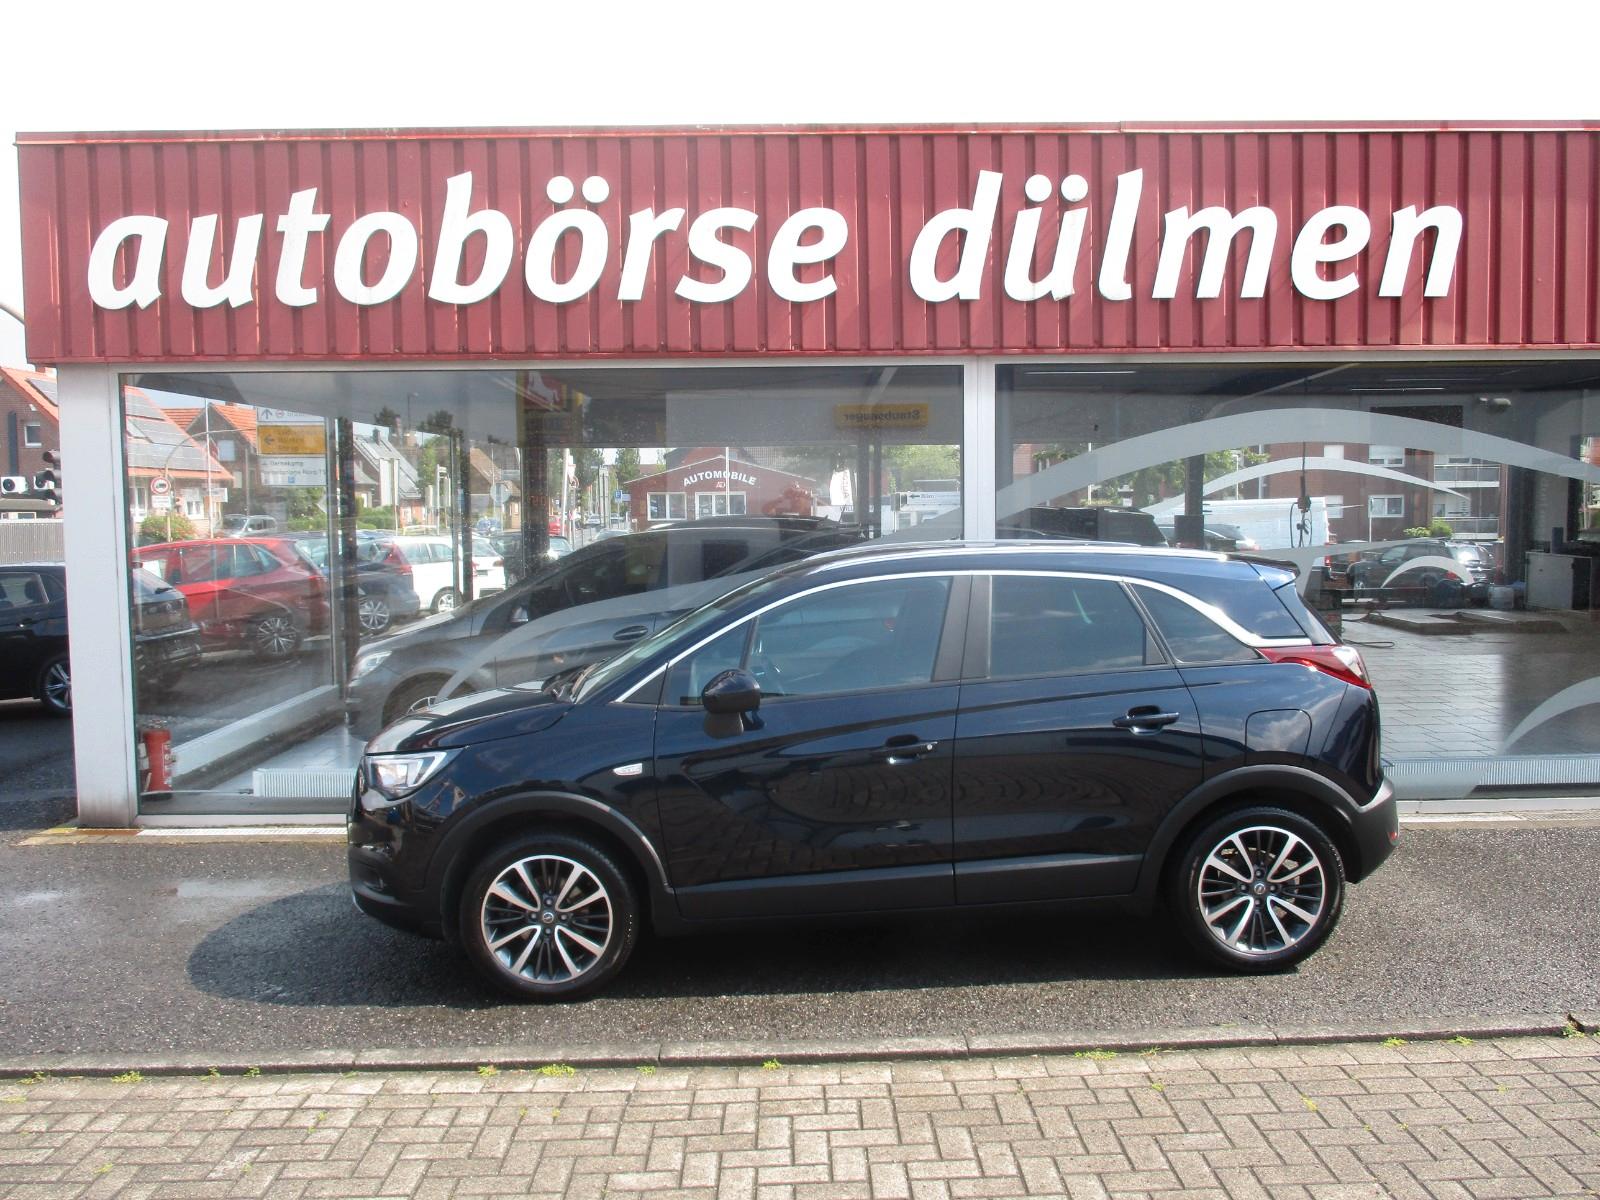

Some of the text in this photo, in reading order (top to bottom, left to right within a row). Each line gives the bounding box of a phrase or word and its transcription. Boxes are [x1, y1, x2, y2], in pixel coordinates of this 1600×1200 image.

[87, 168, 1464, 310] autobörse dülmen
[683, 470, 757, 487] AUTOMOBILE
